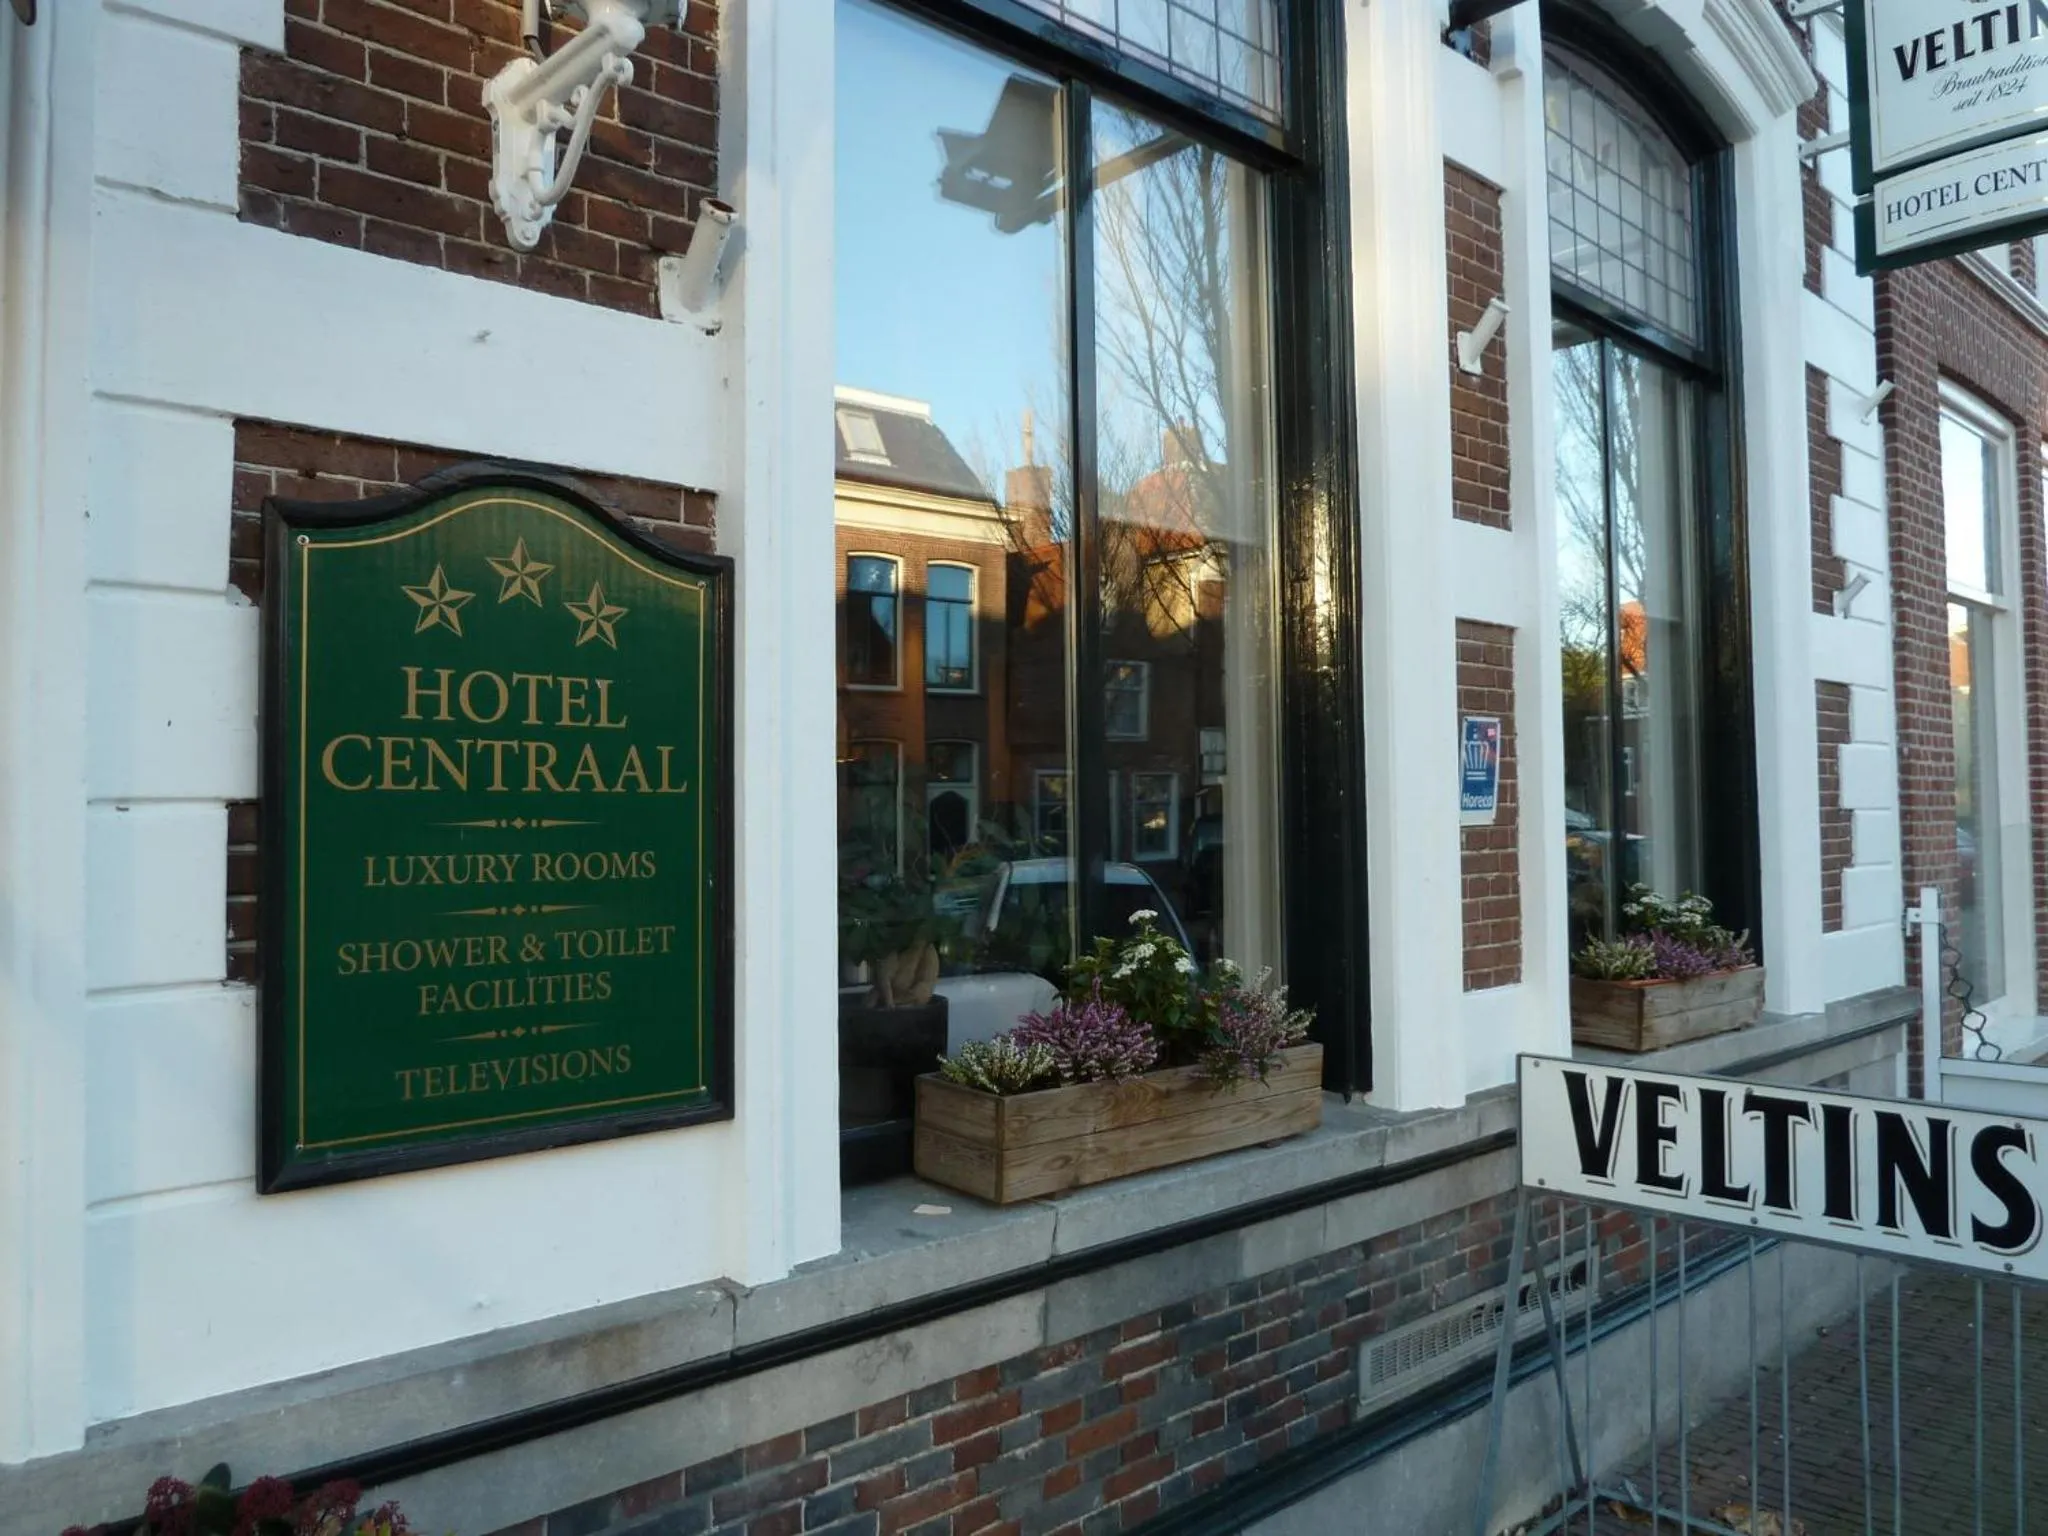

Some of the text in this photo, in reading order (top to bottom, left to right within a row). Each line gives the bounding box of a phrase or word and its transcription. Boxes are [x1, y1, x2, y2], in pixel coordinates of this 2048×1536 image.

[1986, 76, 2028, 102] 1824
[1886, 158, 2048, 224] HOTEL CENT
[402, 666, 627, 728] HOTEL
[321, 735, 688, 793] CENTRAAL
[1462, 792, 1493, 808] Horeca
[364, 850, 656, 887] LUXURY ROOMS
[338, 925, 676, 976] SHOWER & TOILET
[418, 971, 612, 1015] FACILITIES
[396, 1045, 632, 1101] TELEVISIONS
[1562, 1070, 2043, 1256] VELTINS
